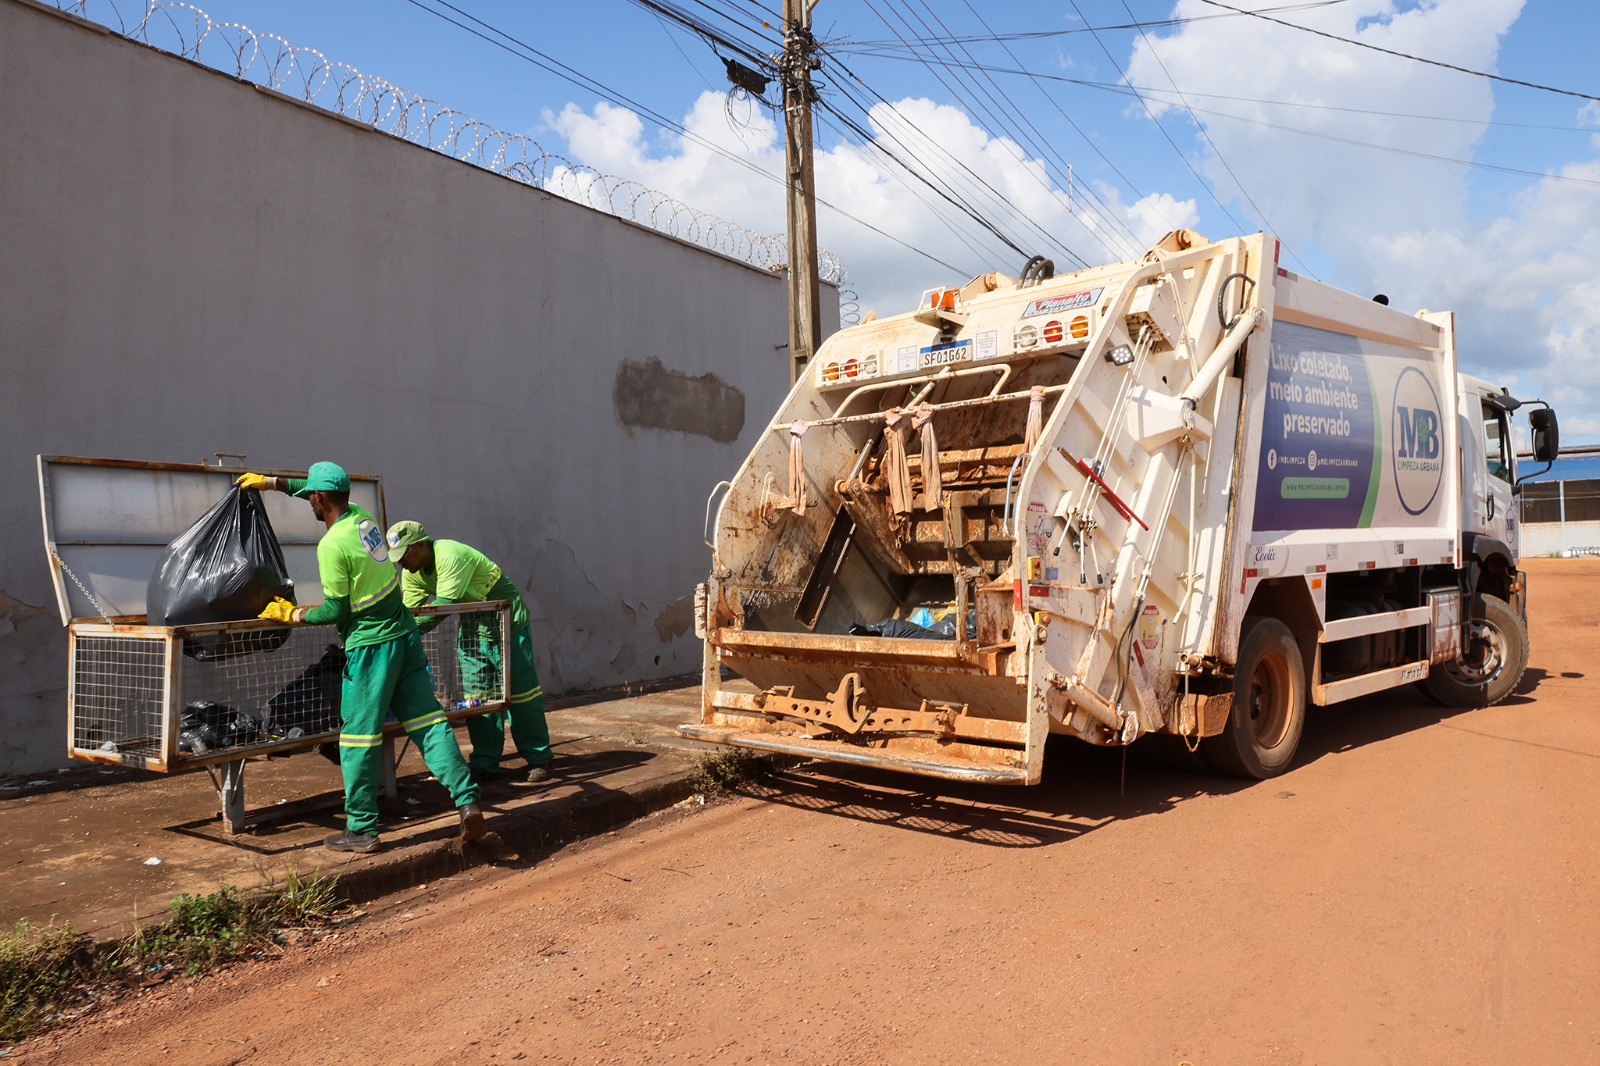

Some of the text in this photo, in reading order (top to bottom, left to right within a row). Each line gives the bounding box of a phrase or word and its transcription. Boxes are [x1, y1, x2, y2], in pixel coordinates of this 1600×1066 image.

[1038, 293, 1090, 310] Planalto
[1270, 342, 1353, 385] Lixo coletado,
[1270, 376, 1358, 409] meio ambiente
[1283, 410, 1350, 439] preservado
[1397, 406, 1439, 459] MB
[1398, 461, 1439, 471] LIMPEZA URBANA
[363, 526, 382, 552] MB
